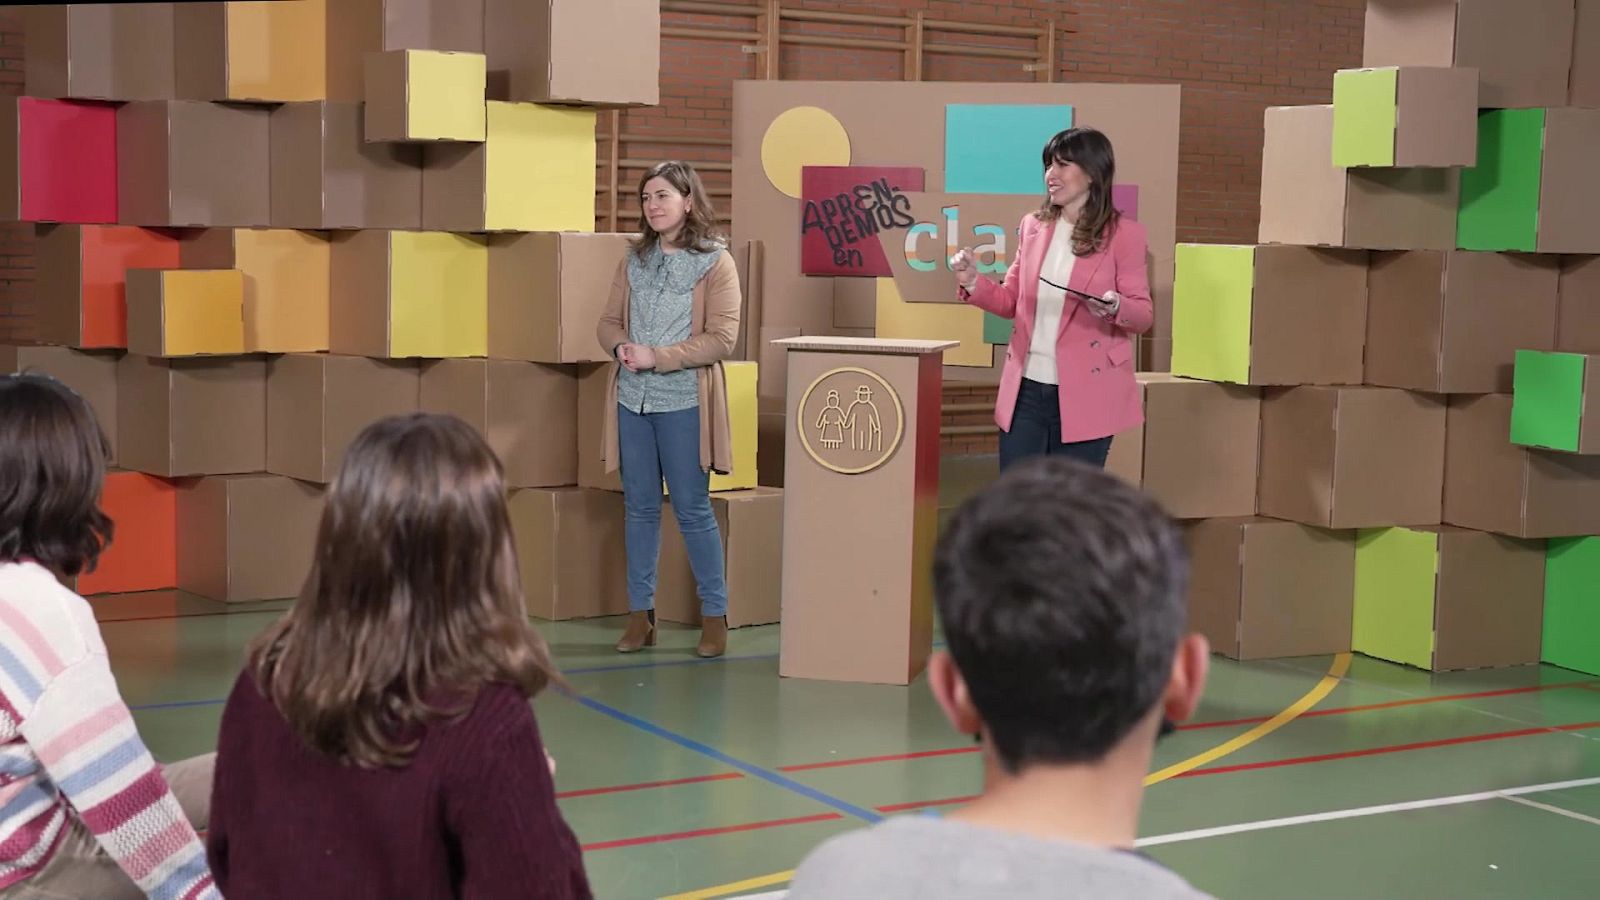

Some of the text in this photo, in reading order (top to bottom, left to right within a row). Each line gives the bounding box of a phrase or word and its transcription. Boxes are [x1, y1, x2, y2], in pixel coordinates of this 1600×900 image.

[824, 194, 915, 251] DEMOS
[904, 204, 1021, 273] cla
[833, 248, 863, 268] en
